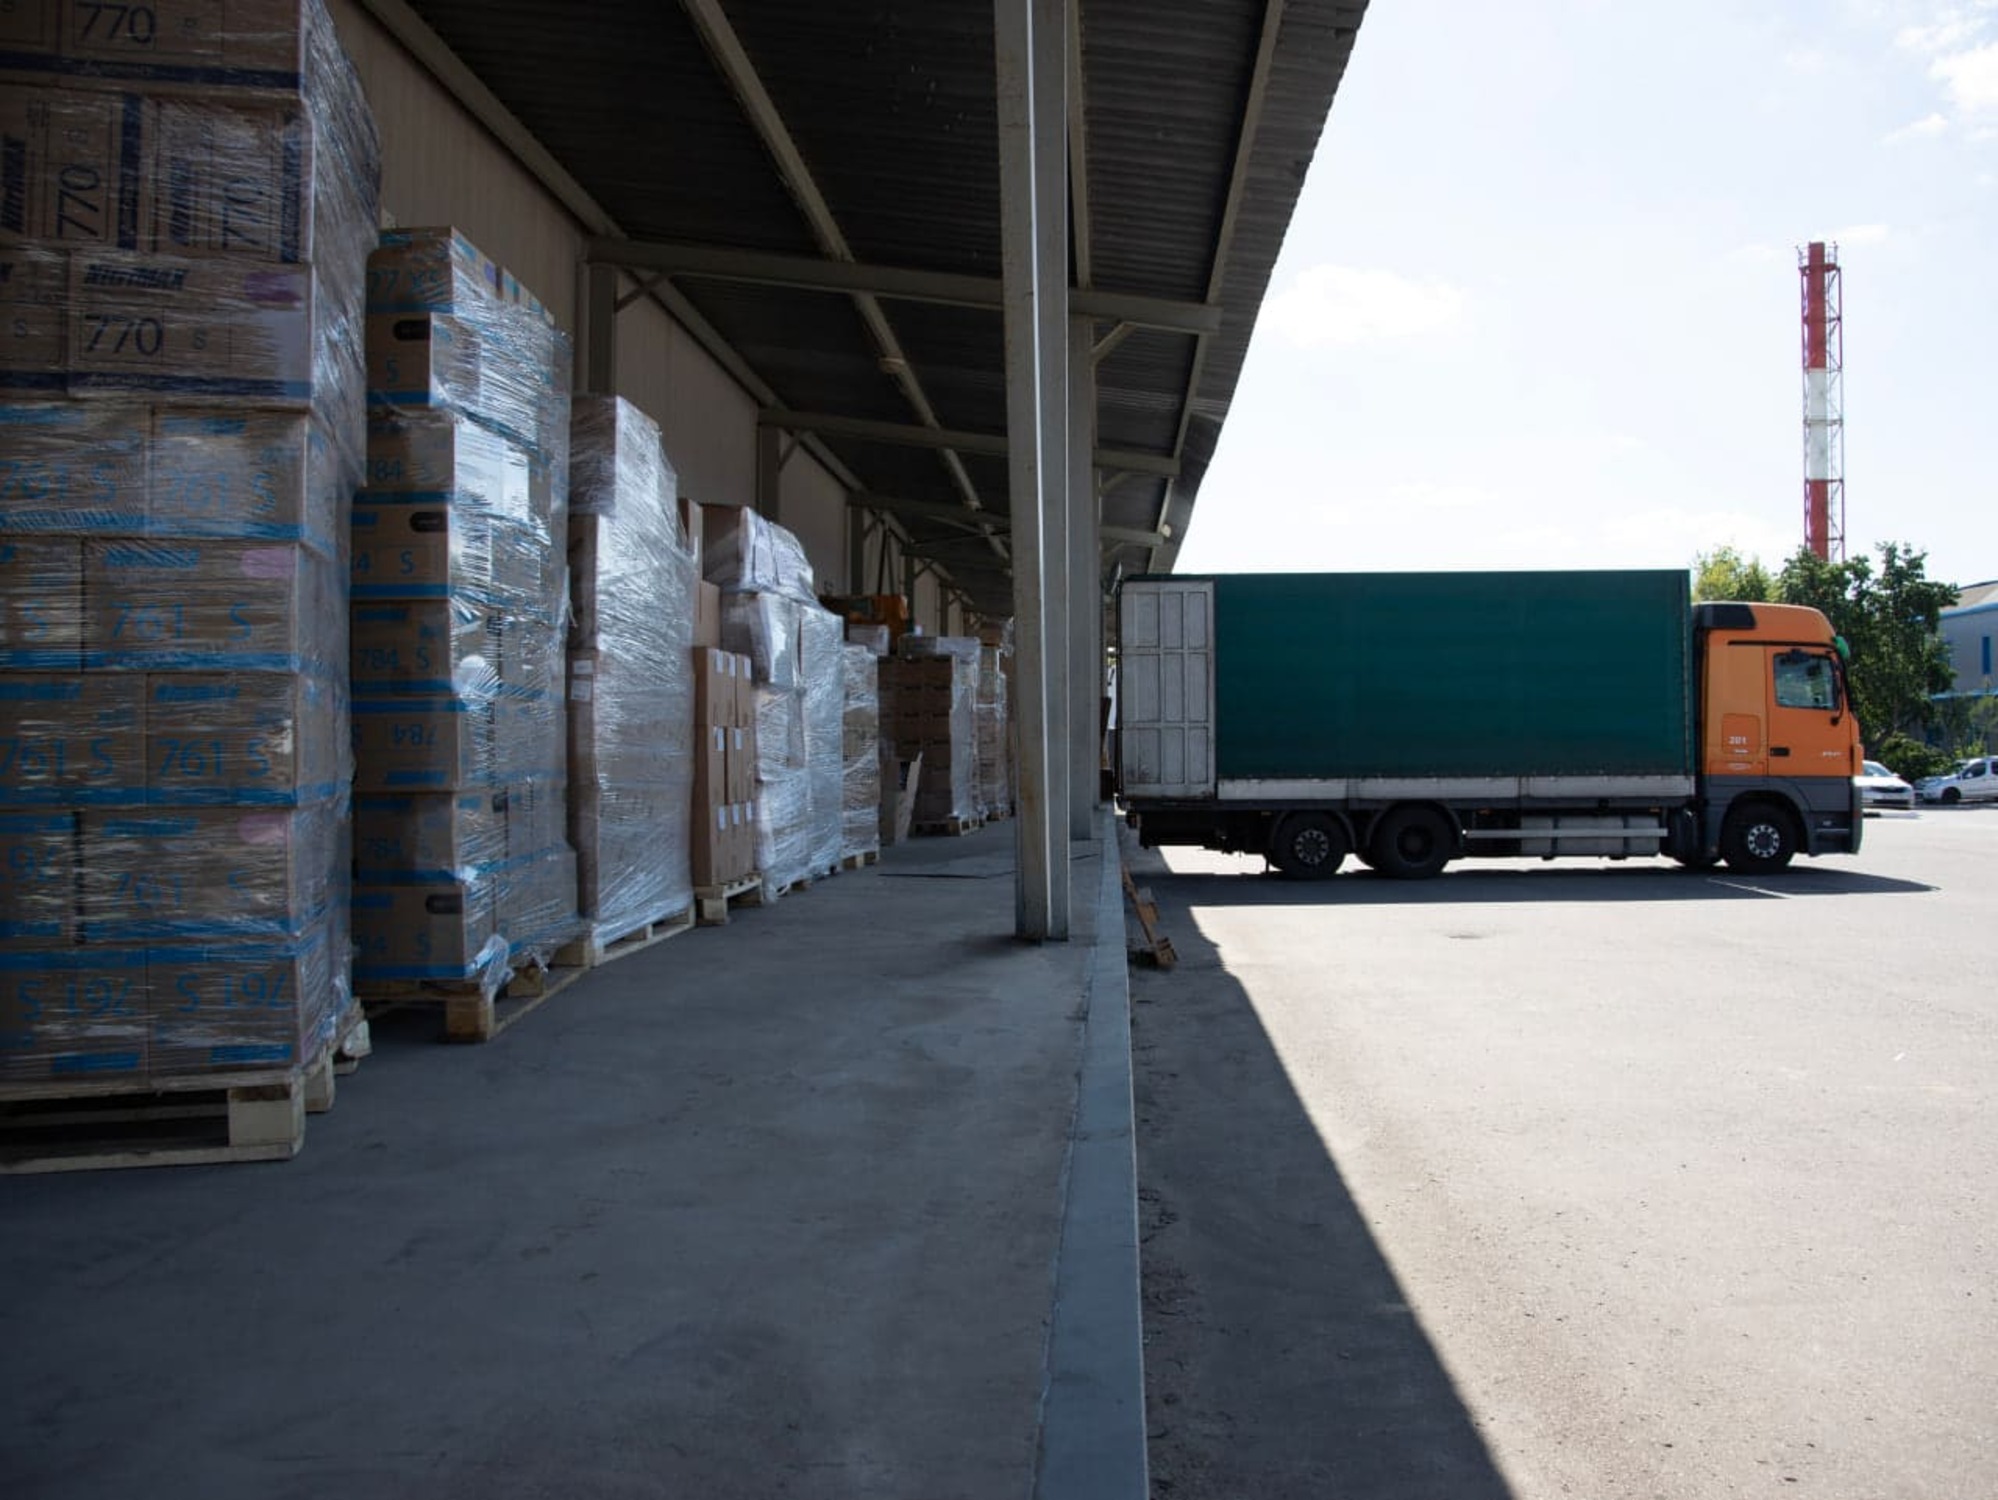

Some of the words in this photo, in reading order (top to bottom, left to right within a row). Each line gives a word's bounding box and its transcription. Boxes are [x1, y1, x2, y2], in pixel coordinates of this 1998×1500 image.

[76, 2, 156, 43] 770
[58, 166, 98, 238] 770
[85, 314, 163, 356] 770
[110, 602, 185, 640] 761
[228, 602, 250, 640] S
[0, 738, 65, 778] 761
[89, 738, 114, 778] S
[156, 738, 226, 778] 761
[175, 973, 201, 1013] S
[223, 973, 287, 1008] 761
